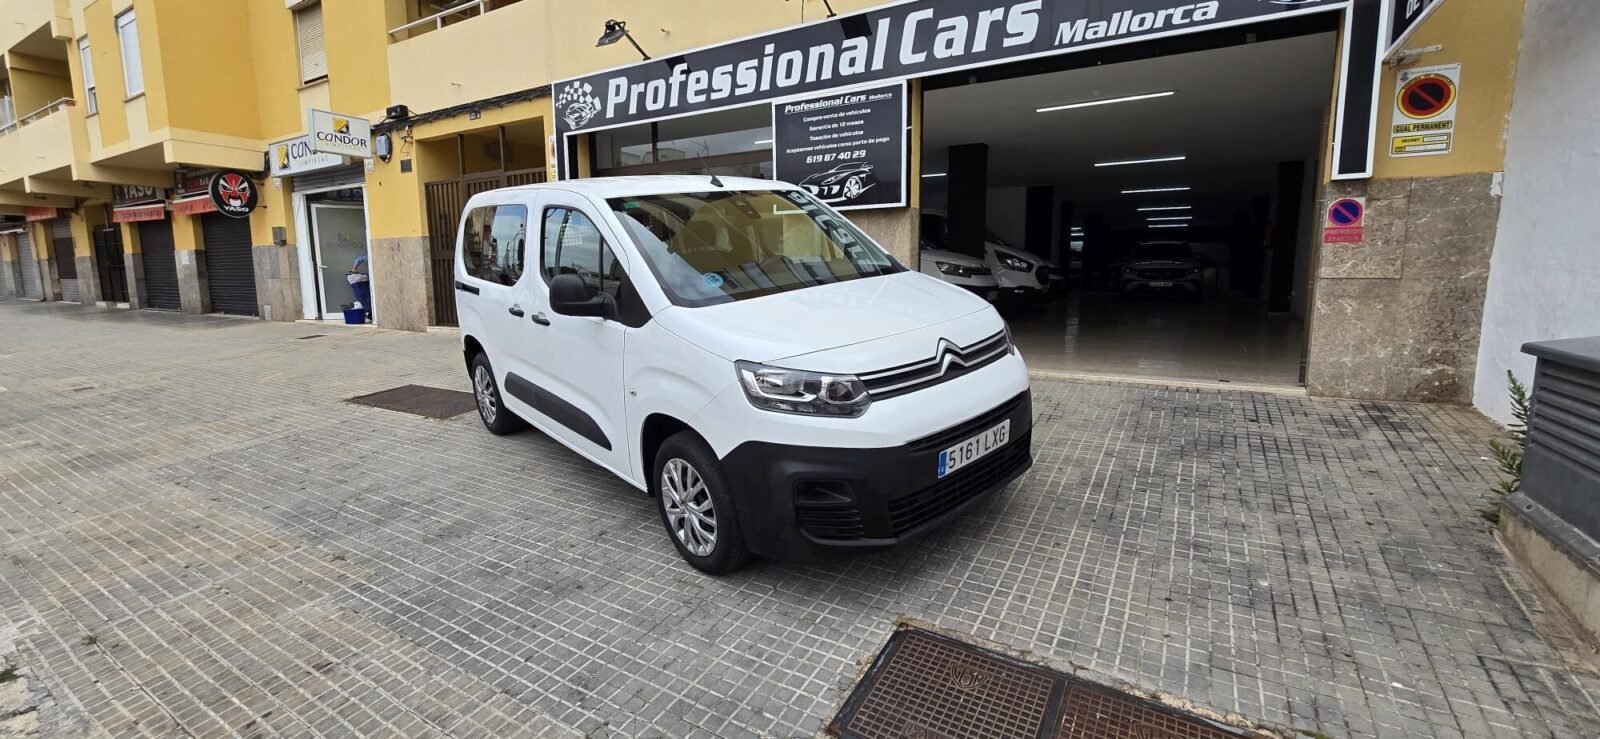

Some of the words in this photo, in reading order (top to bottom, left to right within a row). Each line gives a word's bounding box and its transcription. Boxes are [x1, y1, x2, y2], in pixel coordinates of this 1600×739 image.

[606, 17, 890, 119] Professional
[900, 1, 1042, 65] Cars
[1054, 0, 1219, 46] Mallorca
[785, 96, 843, 113] Professional
[844, 94, 867, 104] Cars
[1412, 121, 1450, 131] PERMANENT
[806, 155, 823, 164] 619
[823, 153, 837, 162] 87
[837, 151, 852, 160] 40
[852, 149, 867, 158] 29
[948, 438, 980, 469] 5161
[984, 425, 1006, 451] LXG
